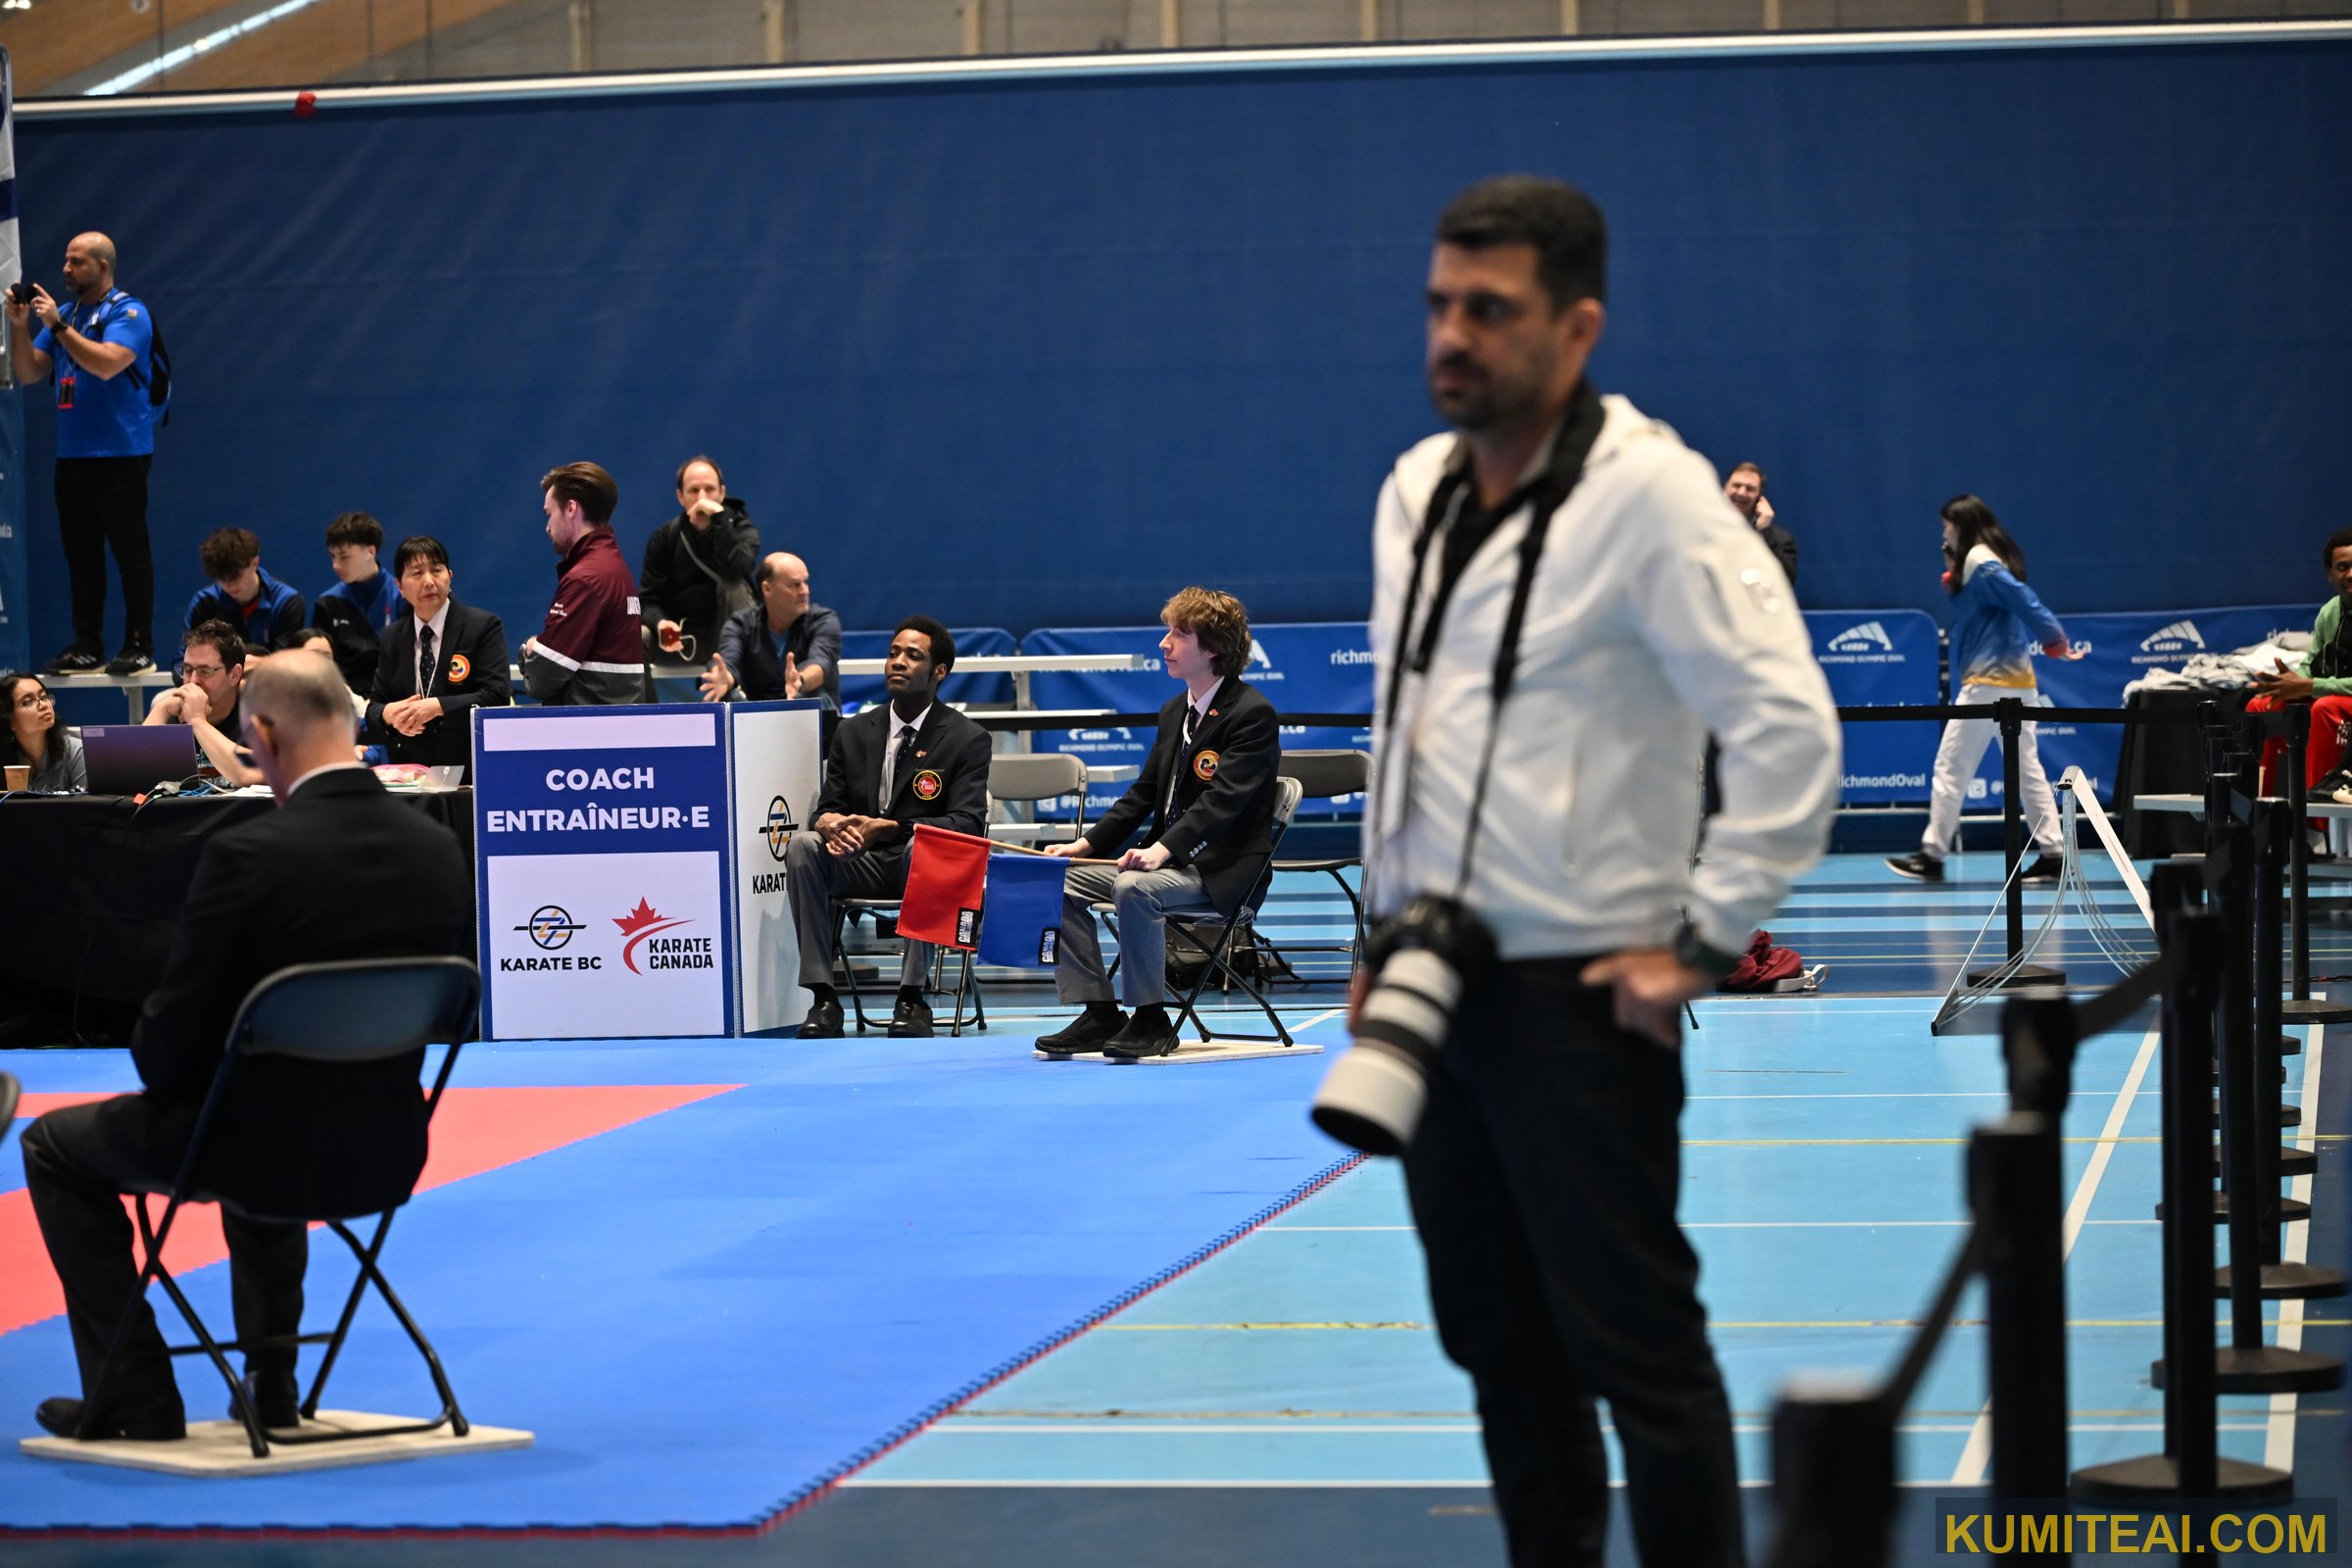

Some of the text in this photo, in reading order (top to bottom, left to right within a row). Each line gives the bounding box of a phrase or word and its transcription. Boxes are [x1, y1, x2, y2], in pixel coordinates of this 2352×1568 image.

[546, 767, 655, 791] COACH
[753, 872, 788, 894] KARAT
[649, 938, 711, 954] KARATE
[501, 956, 602, 971] KARATE BC
[649, 954, 713, 969] CANADA
